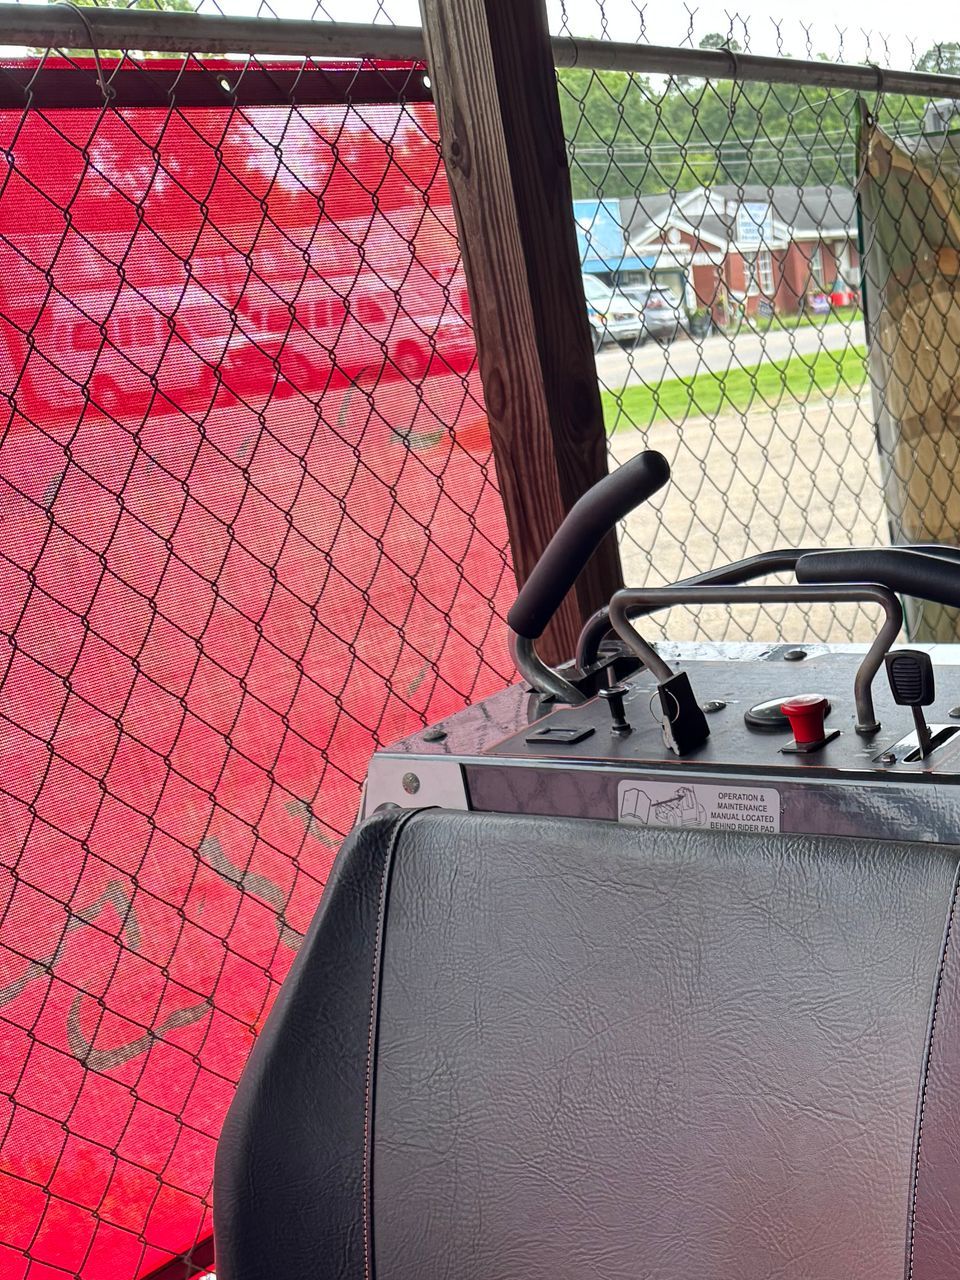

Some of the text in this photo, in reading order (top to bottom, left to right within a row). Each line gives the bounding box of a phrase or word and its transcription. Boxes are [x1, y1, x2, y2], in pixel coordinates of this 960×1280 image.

[718, 792, 758, 801] OPERATION
[717, 802, 768, 813] MAINTENANCE
[710, 812, 775, 823] MANUAL LOCATED
[710, 822, 775, 833] BEHIND RIDER PAD
